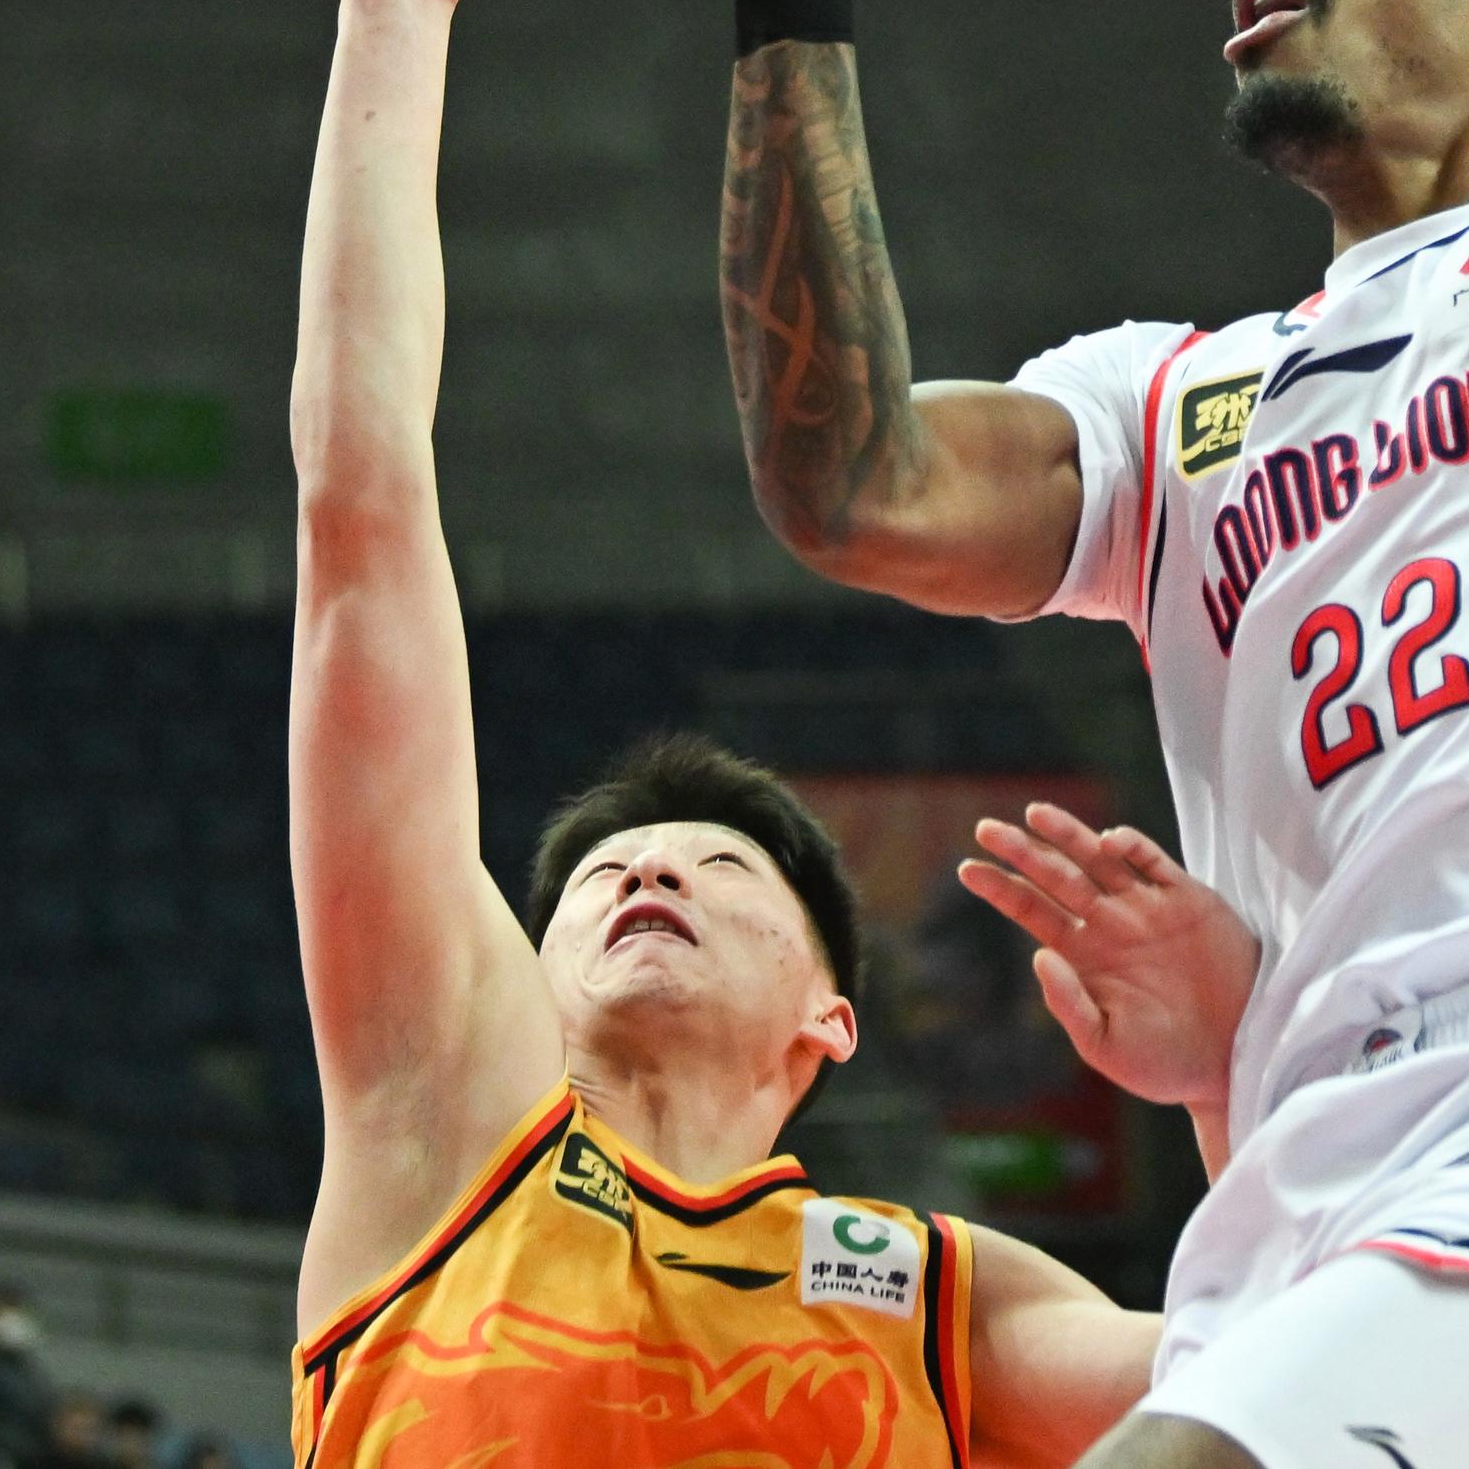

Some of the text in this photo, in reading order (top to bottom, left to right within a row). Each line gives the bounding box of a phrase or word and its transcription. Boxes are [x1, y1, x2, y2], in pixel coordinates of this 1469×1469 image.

[811, 1261, 909, 1288] 中国人寿
[811, 1281, 905, 1303] CHINA LIFE
